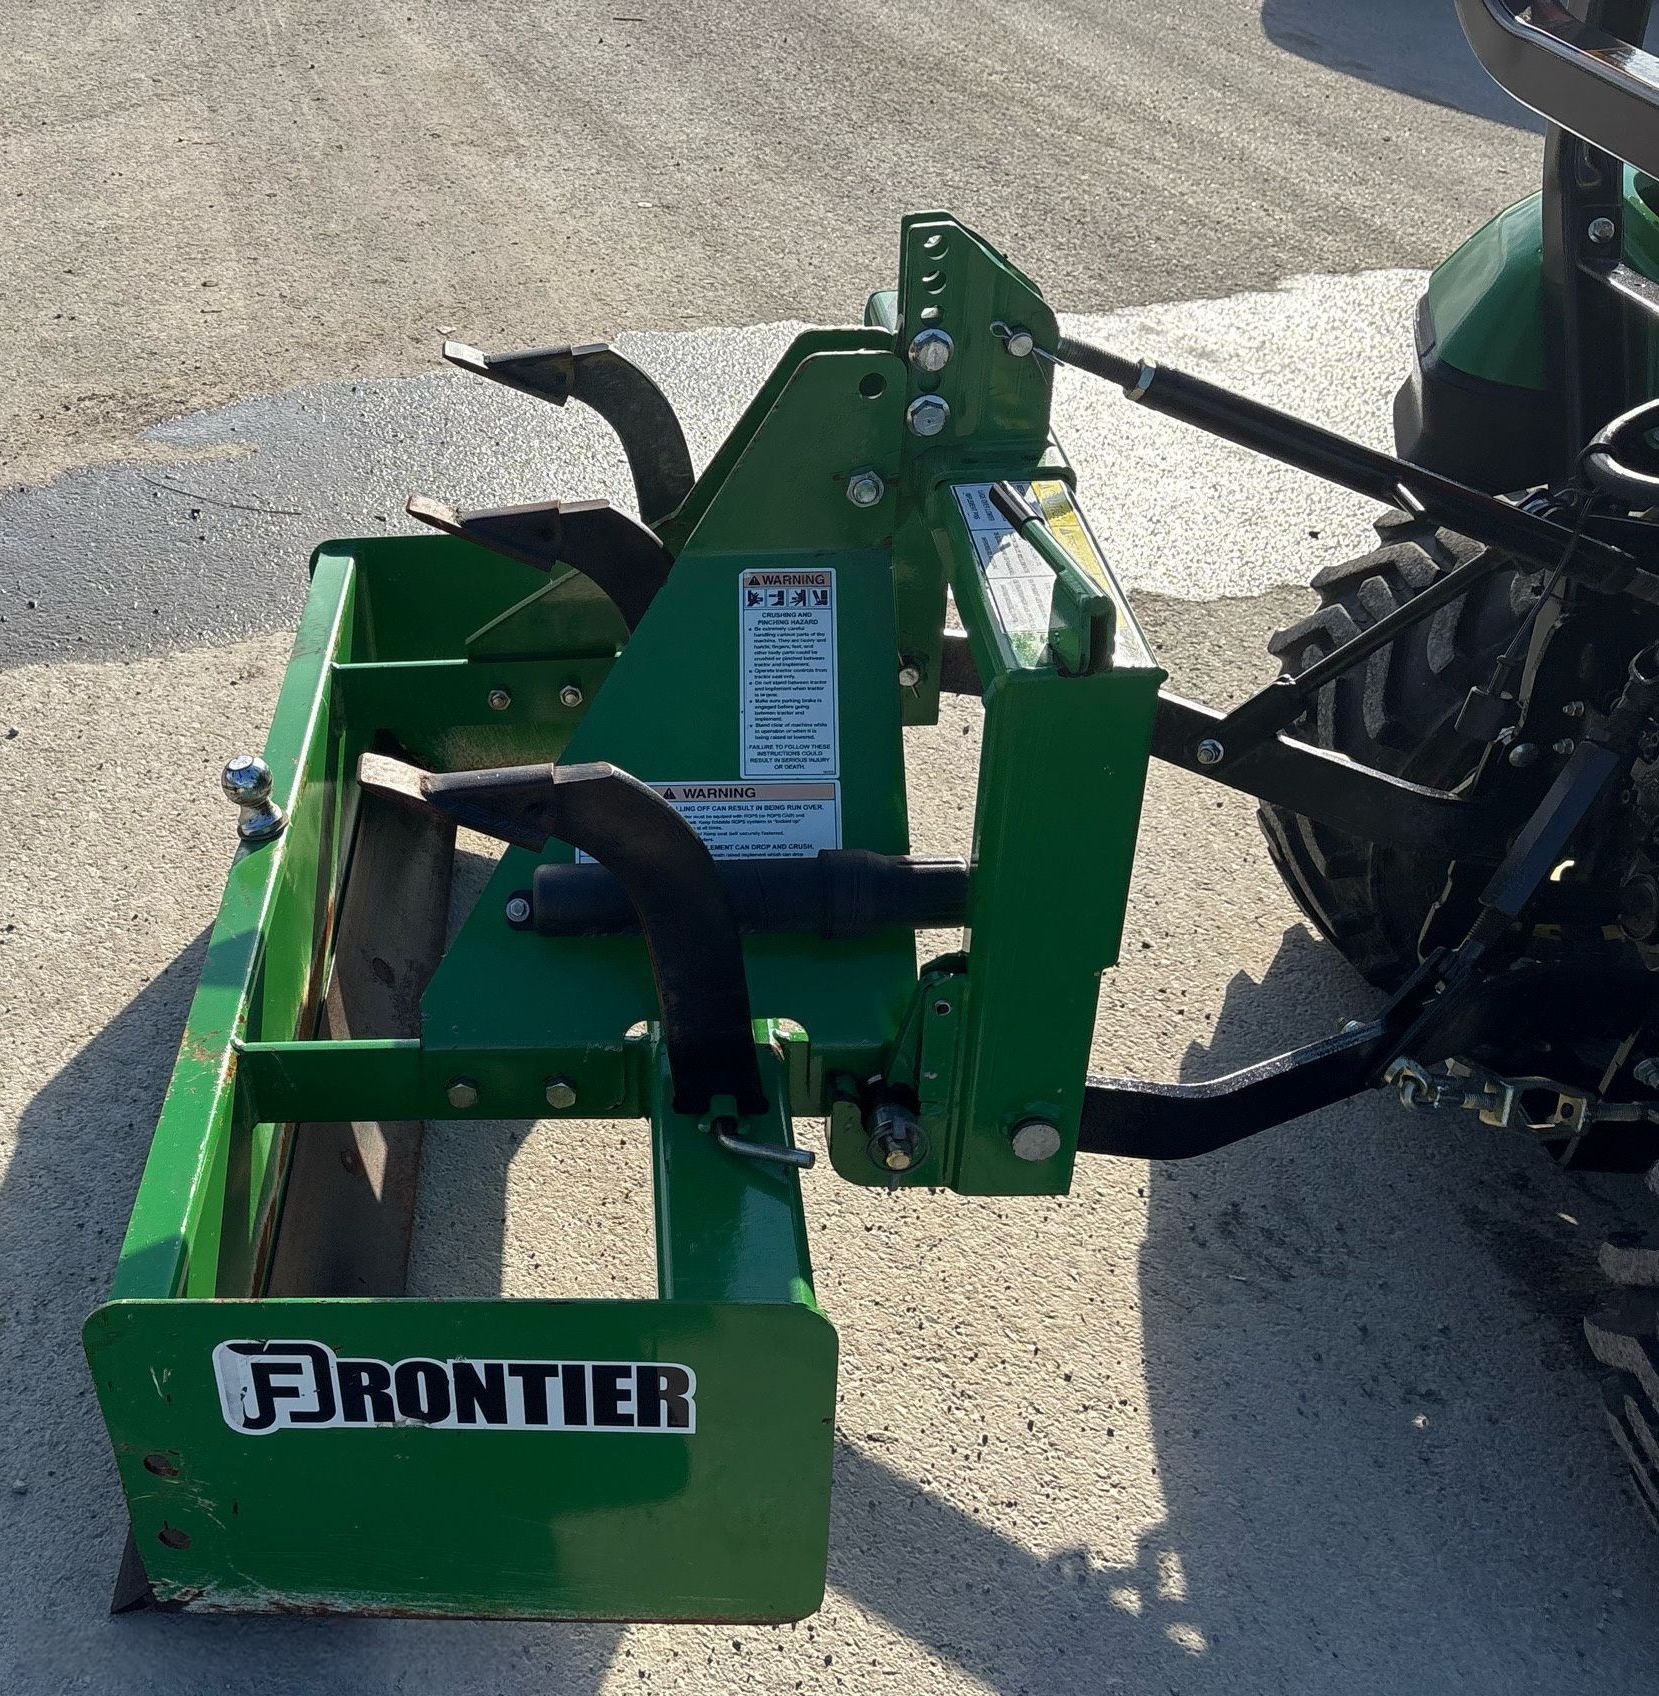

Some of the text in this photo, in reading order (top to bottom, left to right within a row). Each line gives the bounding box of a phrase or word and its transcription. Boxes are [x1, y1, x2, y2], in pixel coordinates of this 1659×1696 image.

[762, 574, 825, 585] WARNING
[683, 787, 756, 799] WARNING
[227, 1342, 690, 1430] FRONTIER
